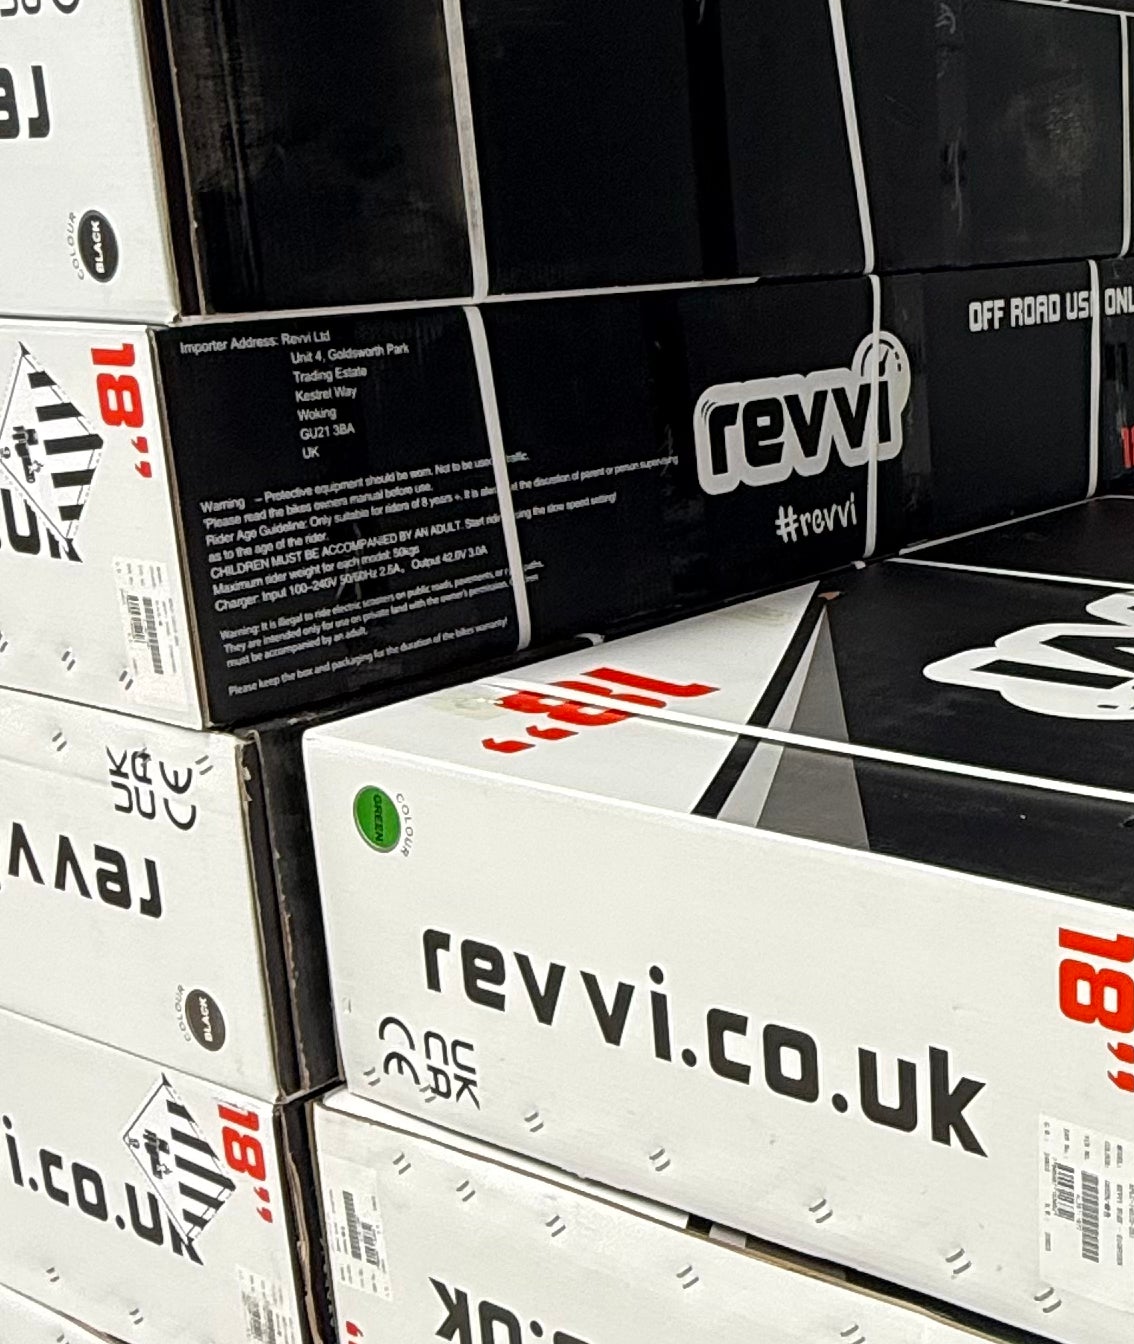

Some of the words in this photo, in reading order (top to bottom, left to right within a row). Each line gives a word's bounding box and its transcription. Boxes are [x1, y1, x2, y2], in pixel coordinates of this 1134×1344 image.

[70, 211, 84, 281] COLOUR
[92, 219, 105, 274] BLACK
[969, 299, 1004, 331] OFF
[1011, 294, 1060, 327] ROAD
[180, 341, 227, 355] Importer
[231, 337, 278, 349] Address:
[281, 333, 311, 344] Revvi
[314, 331, 330, 342] Ltd
[291, 352, 313, 364] Unit
[315, 351, 325, 362] 4,
[328, 345, 384, 360] Goldsworth
[387, 343, 409, 354] Park
[293, 370, 333, 383] Trading
[335, 367, 367, 379] Estate
[295, 388, 332, 402] Kestrel
[334, 386, 356, 398] Way
[704, 341, 900, 479] revvi
[297, 408, 336, 421] Woking
[300, 426, 329, 440] GU21
[333, 423, 355, 435] 3BA
[302, 446, 319, 459] UK
[200, 498, 245, 513] Warning
[264, 487, 312, 502] Protective
[315, 478, 363, 495] equipment
[206, 533, 234, 546] Rider
[237, 529, 257, 542] Age
[309, 515, 332, 527] Only
[775, 493, 856, 542] #revvi
[209, 553, 222, 562] as
[223, 550, 234, 559] to
[235, 547, 252, 557] the
[255, 543, 273, 555] age
[287, 537, 303, 547] the
[210, 558, 269, 579] CHILDREN
[271, 551, 302, 567] MUST
[304, 548, 319, 560] BE
[399, 530, 411, 541] BY
[415, 527, 428, 538] AN
[213, 578, 263, 595] Maximum
[262, 587, 287, 602] Input
[373, 792, 385, 844] GREEN
[396, 791, 414, 858] COLOUR
[202, 996, 212, 1044] BLACK
[423, 929, 987, 1158] revvi.co.uk
[0, 1116, 204, 1265] i.co.uk
